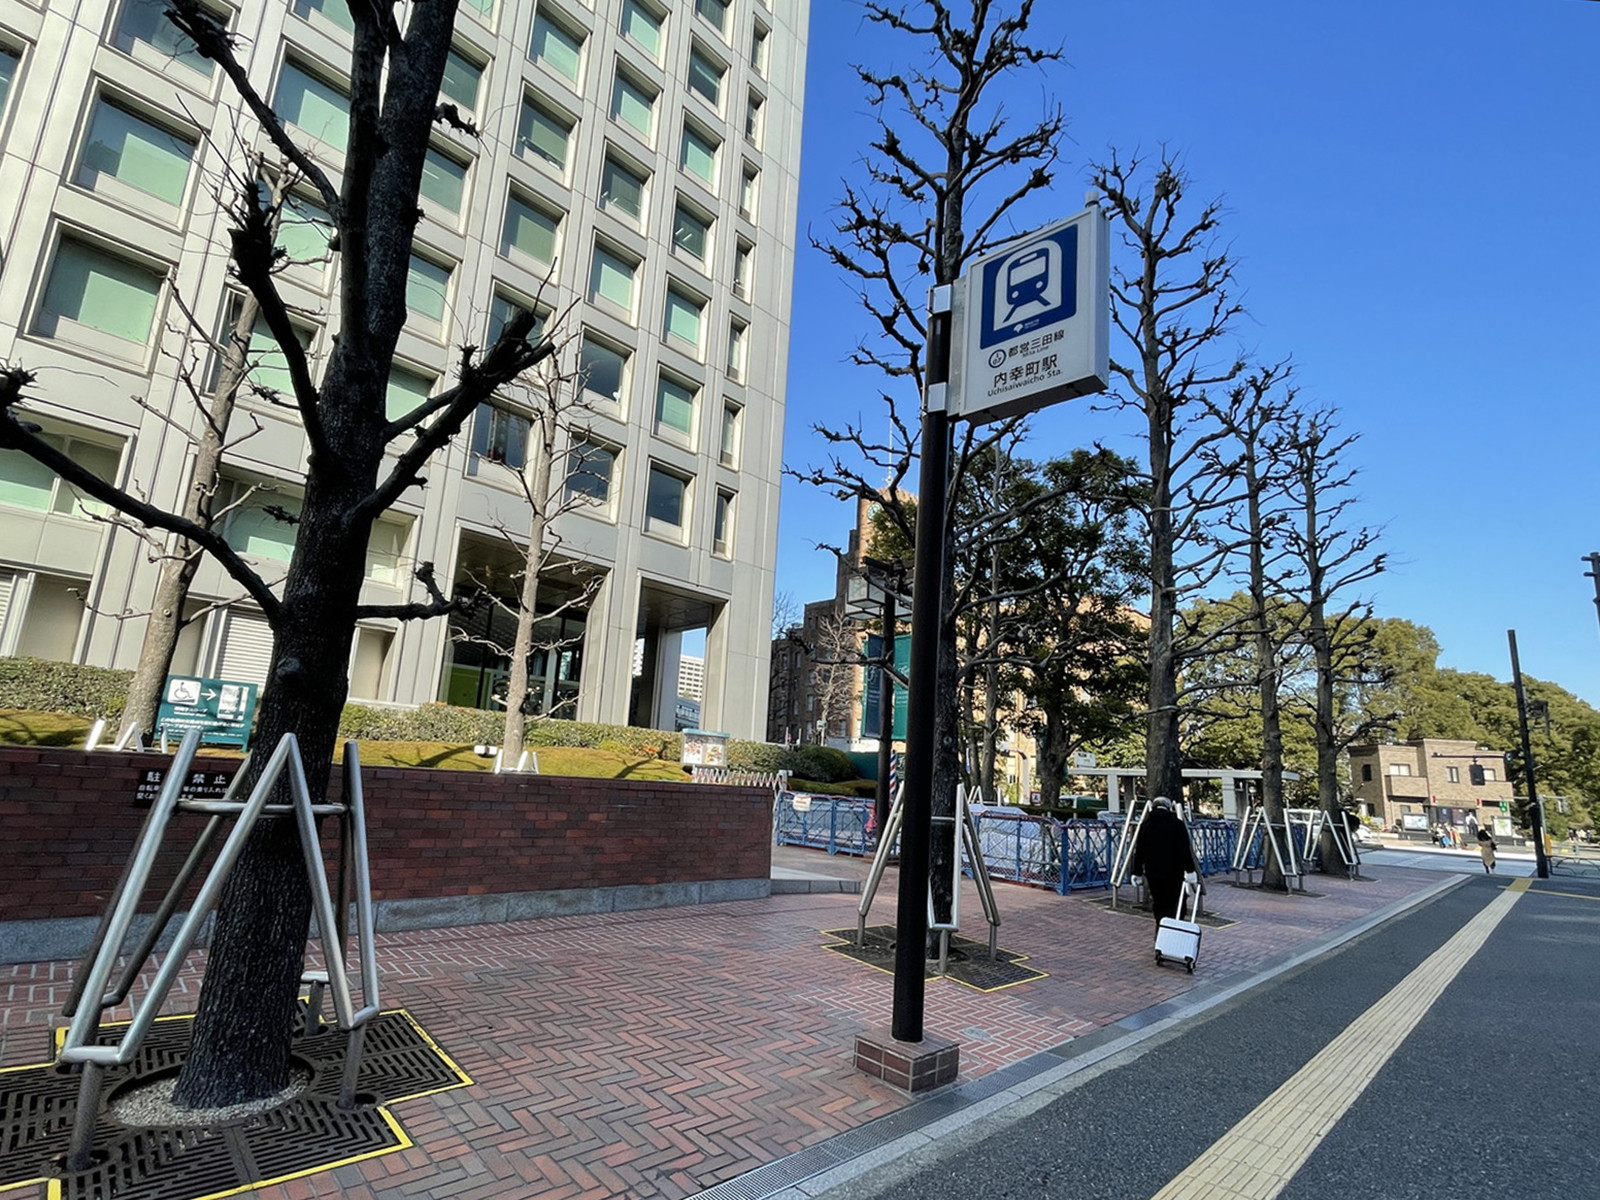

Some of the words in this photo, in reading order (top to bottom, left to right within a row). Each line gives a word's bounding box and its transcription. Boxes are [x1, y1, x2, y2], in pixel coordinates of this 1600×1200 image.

[1009, 329, 1064, 357] 都営三田線
[987, 374, 1045, 396] Uchisaiwaicho
[1046, 369, 1063, 378] Sta.
[994, 354, 1057, 387] 内幸町駅
[146, 771, 227, 785] 駐禁止
